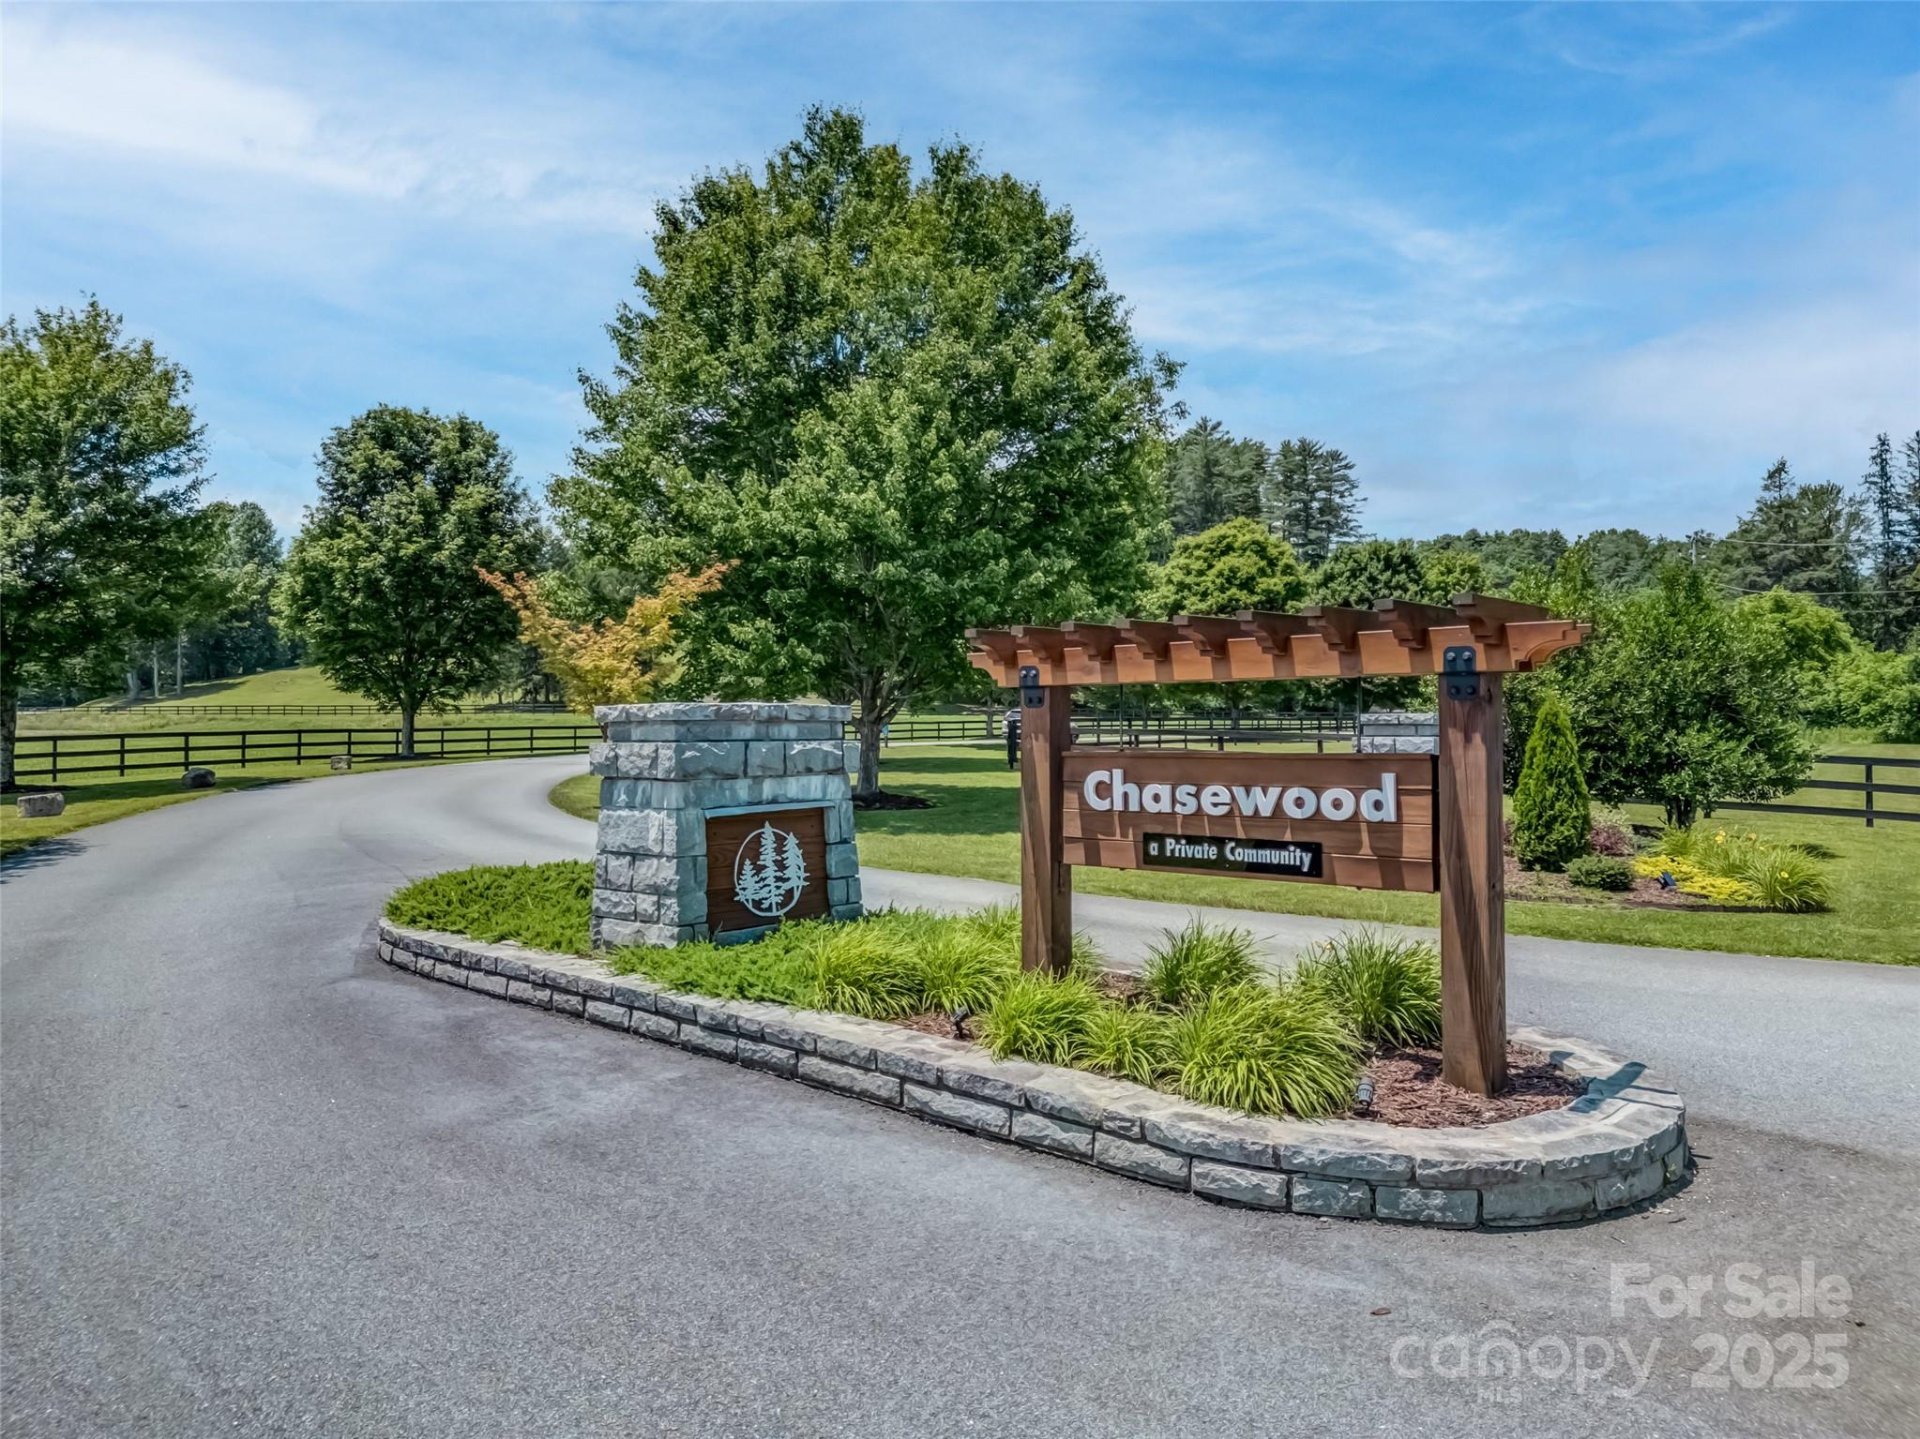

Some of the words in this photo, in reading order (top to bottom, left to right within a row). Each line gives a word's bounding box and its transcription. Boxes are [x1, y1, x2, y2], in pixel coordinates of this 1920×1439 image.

[1083, 768, 1397, 822] Chasewood
[1149, 842, 1158, 856] a
[1165, 839, 1218, 860] Private
[1225, 841, 1312, 872] Community
